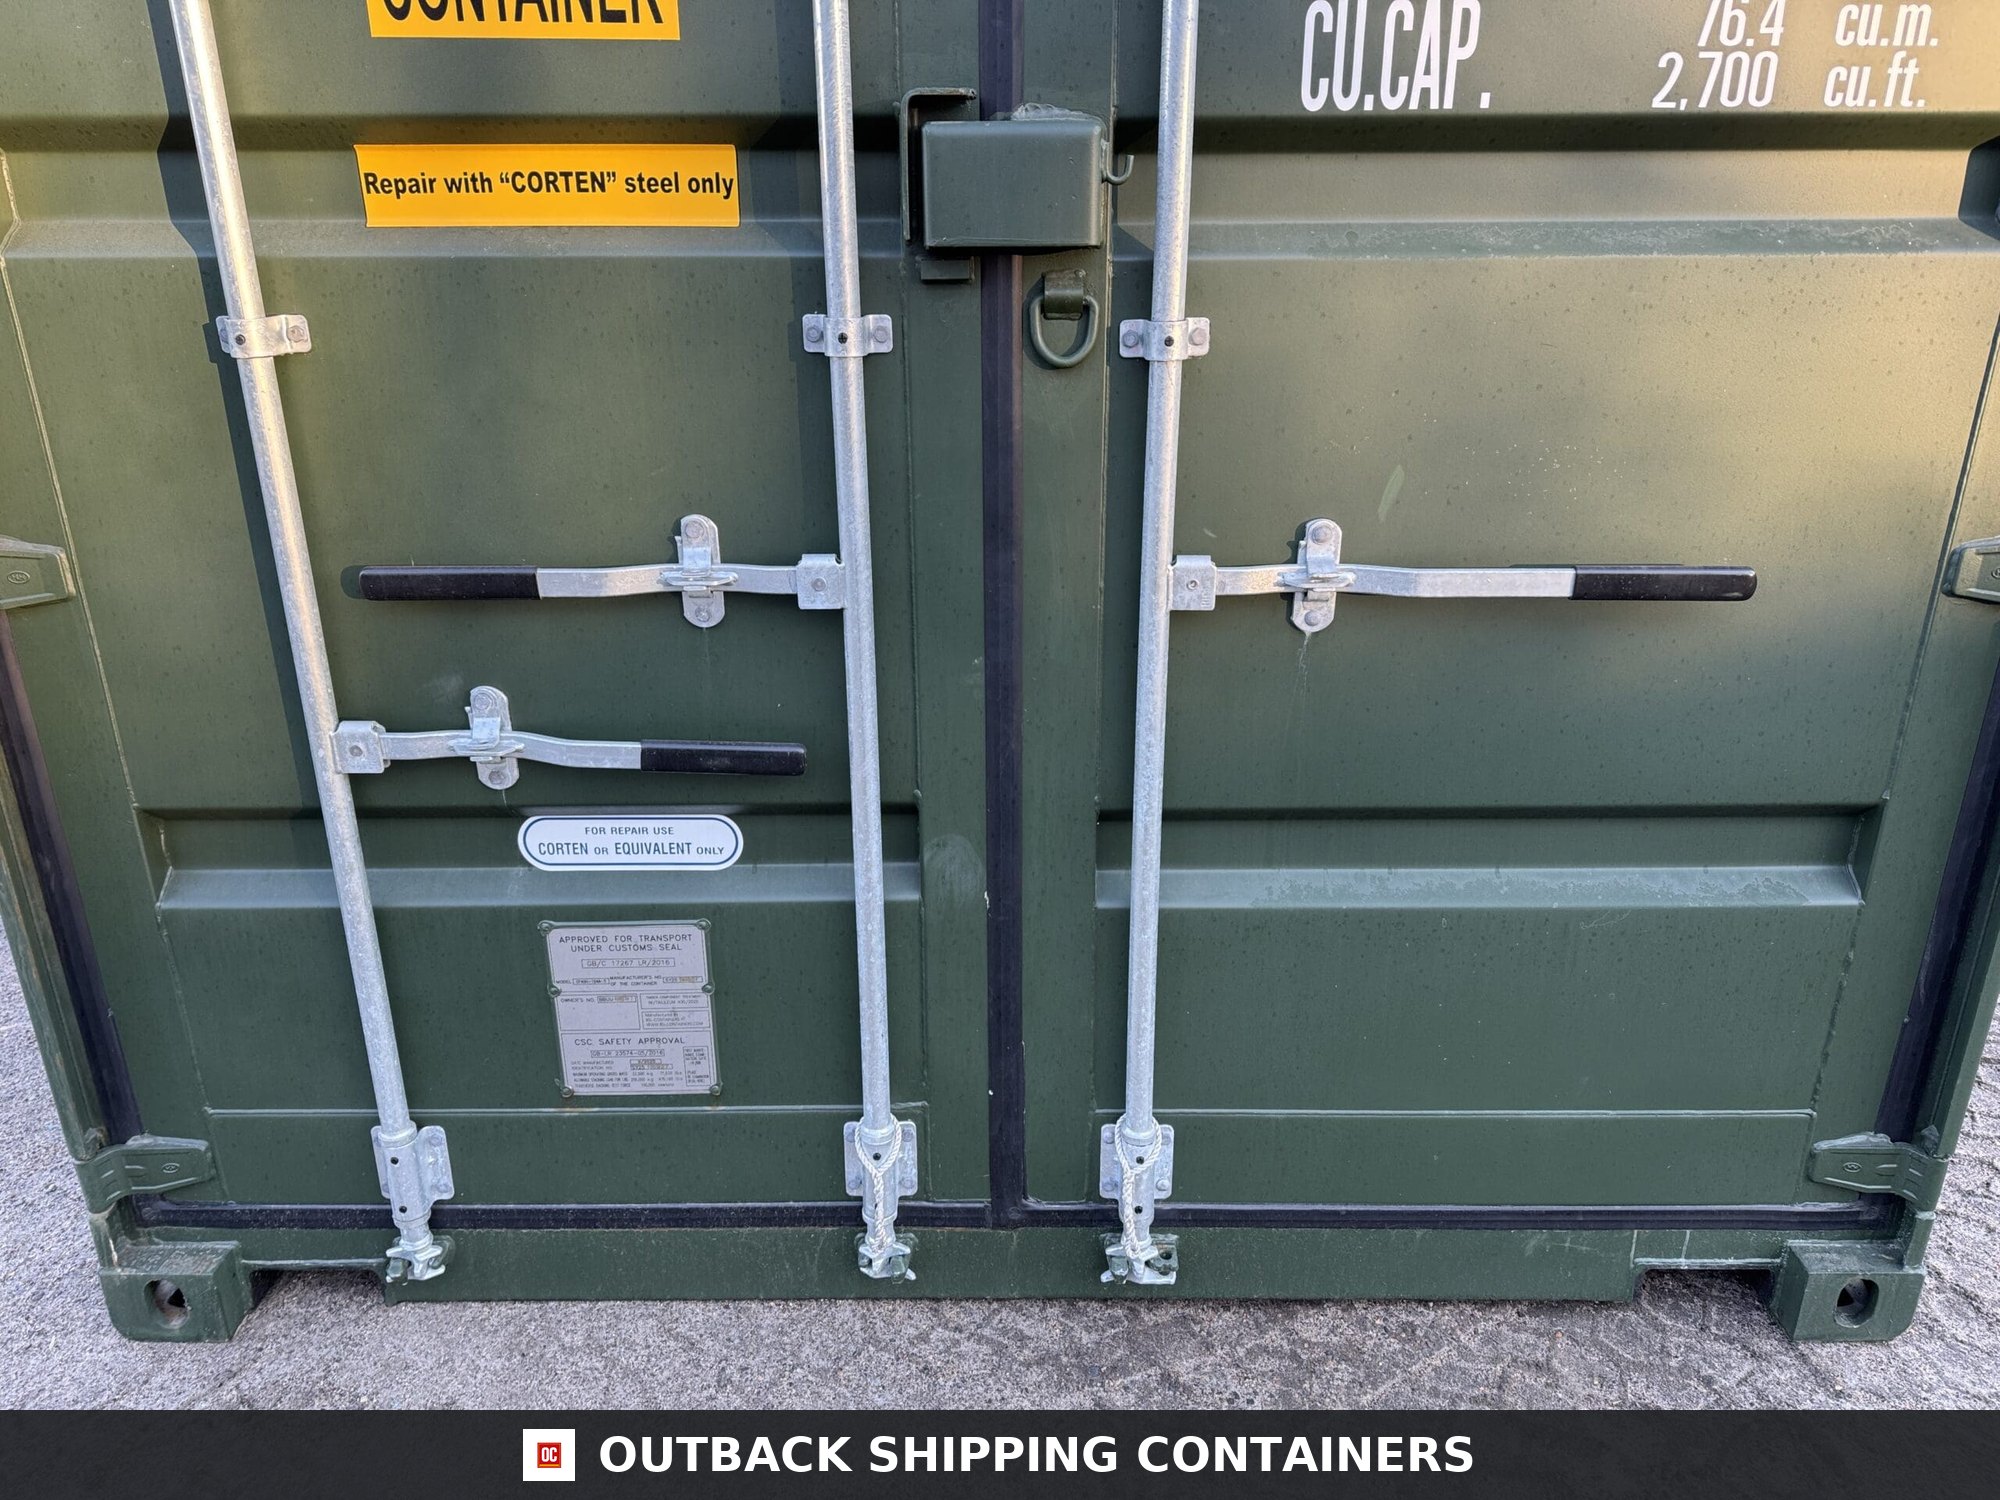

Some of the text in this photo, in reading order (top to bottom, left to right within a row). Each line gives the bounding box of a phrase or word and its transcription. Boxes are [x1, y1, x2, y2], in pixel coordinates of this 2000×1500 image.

[1835, 4, 1939, 46] cu.m.
[1302, 0, 1491, 111] CU.CAP.
[1652, 50, 1926, 110] 2,700 cu.ft.
[363, 171, 734, 199] Repair with “CORTEN” steel only
[585, 827, 674, 835] FOR REPAIR USE
[538, 842, 725, 855] CORTEN OR EQUIVALENT ONLY
[559, 933, 692, 944] APPROVED FOR TRANSPORT
[570, 943, 682, 953] UNDER CUSTOMS SEAL
[586, 959, 607, 967] GB/C
[611, 959, 633, 967] 17267
[574, 1036, 686, 1046] CSC SAFETY APPROVAL
